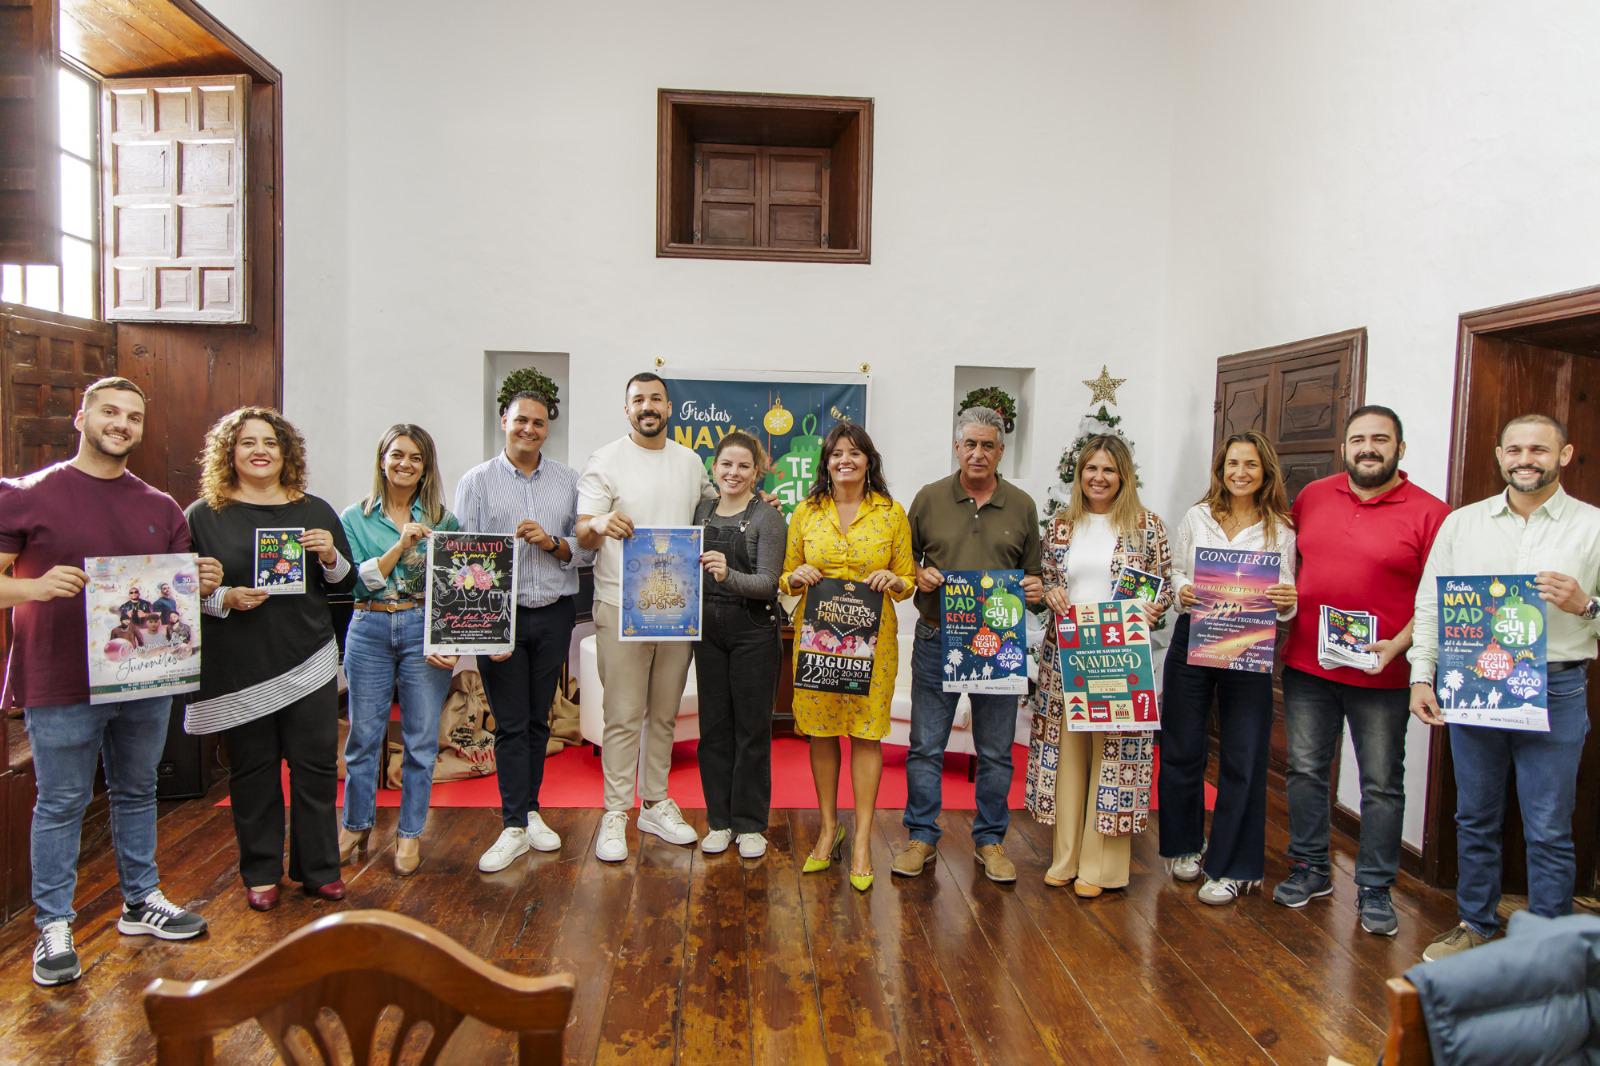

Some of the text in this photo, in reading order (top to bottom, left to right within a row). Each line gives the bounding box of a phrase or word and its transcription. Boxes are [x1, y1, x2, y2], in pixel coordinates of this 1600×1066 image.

[679, 400, 732, 423] Fiestas
[674, 425, 748, 450] NAV
[786, 457, 812, 478] TE
[774, 481, 816, 505] GU
[446, 539, 503, 552] CALICANTO
[1200, 550, 1280, 566] CONCIERTO
[945, 584, 974, 596] NAVI
[1120, 580, 1134, 589] DAD
[1446, 580, 1473, 592] Fiestas
[945, 597, 976, 611] DAD
[992, 597, 1003, 606] TE
[1444, 592, 1481, 606] NAVI
[463, 612, 478, 620] del
[818, 610, 873, 627] PRINCESAS
[946, 612, 976, 623] REYES
[985, 607, 1008, 618] GUI
[1443, 608, 1484, 624] DAD
[1503, 607, 1518, 619] TE
[450, 620, 492, 629] Calicanto
[992, 617, 1009, 627] SE
[1237, 617, 1274, 625] TEGUIBAND
[1494, 620, 1524, 633] GUI
[1445, 626, 1484, 638] REYES
[1503, 632, 1526, 644] SE
[805, 653, 871, 672] TEGUISE
[1068, 652, 1141, 671] NAVIDAD
[1190, 651, 1220, 659] Convento
[1246, 656, 1273, 666] Domingo
[1479, 660, 1509, 669] TEGUI
[802, 664, 822, 683] 22
[822, 667, 840, 679] DIC
[1507, 677, 1541, 686] GRACIO
[1511, 687, 1523, 696] SA
